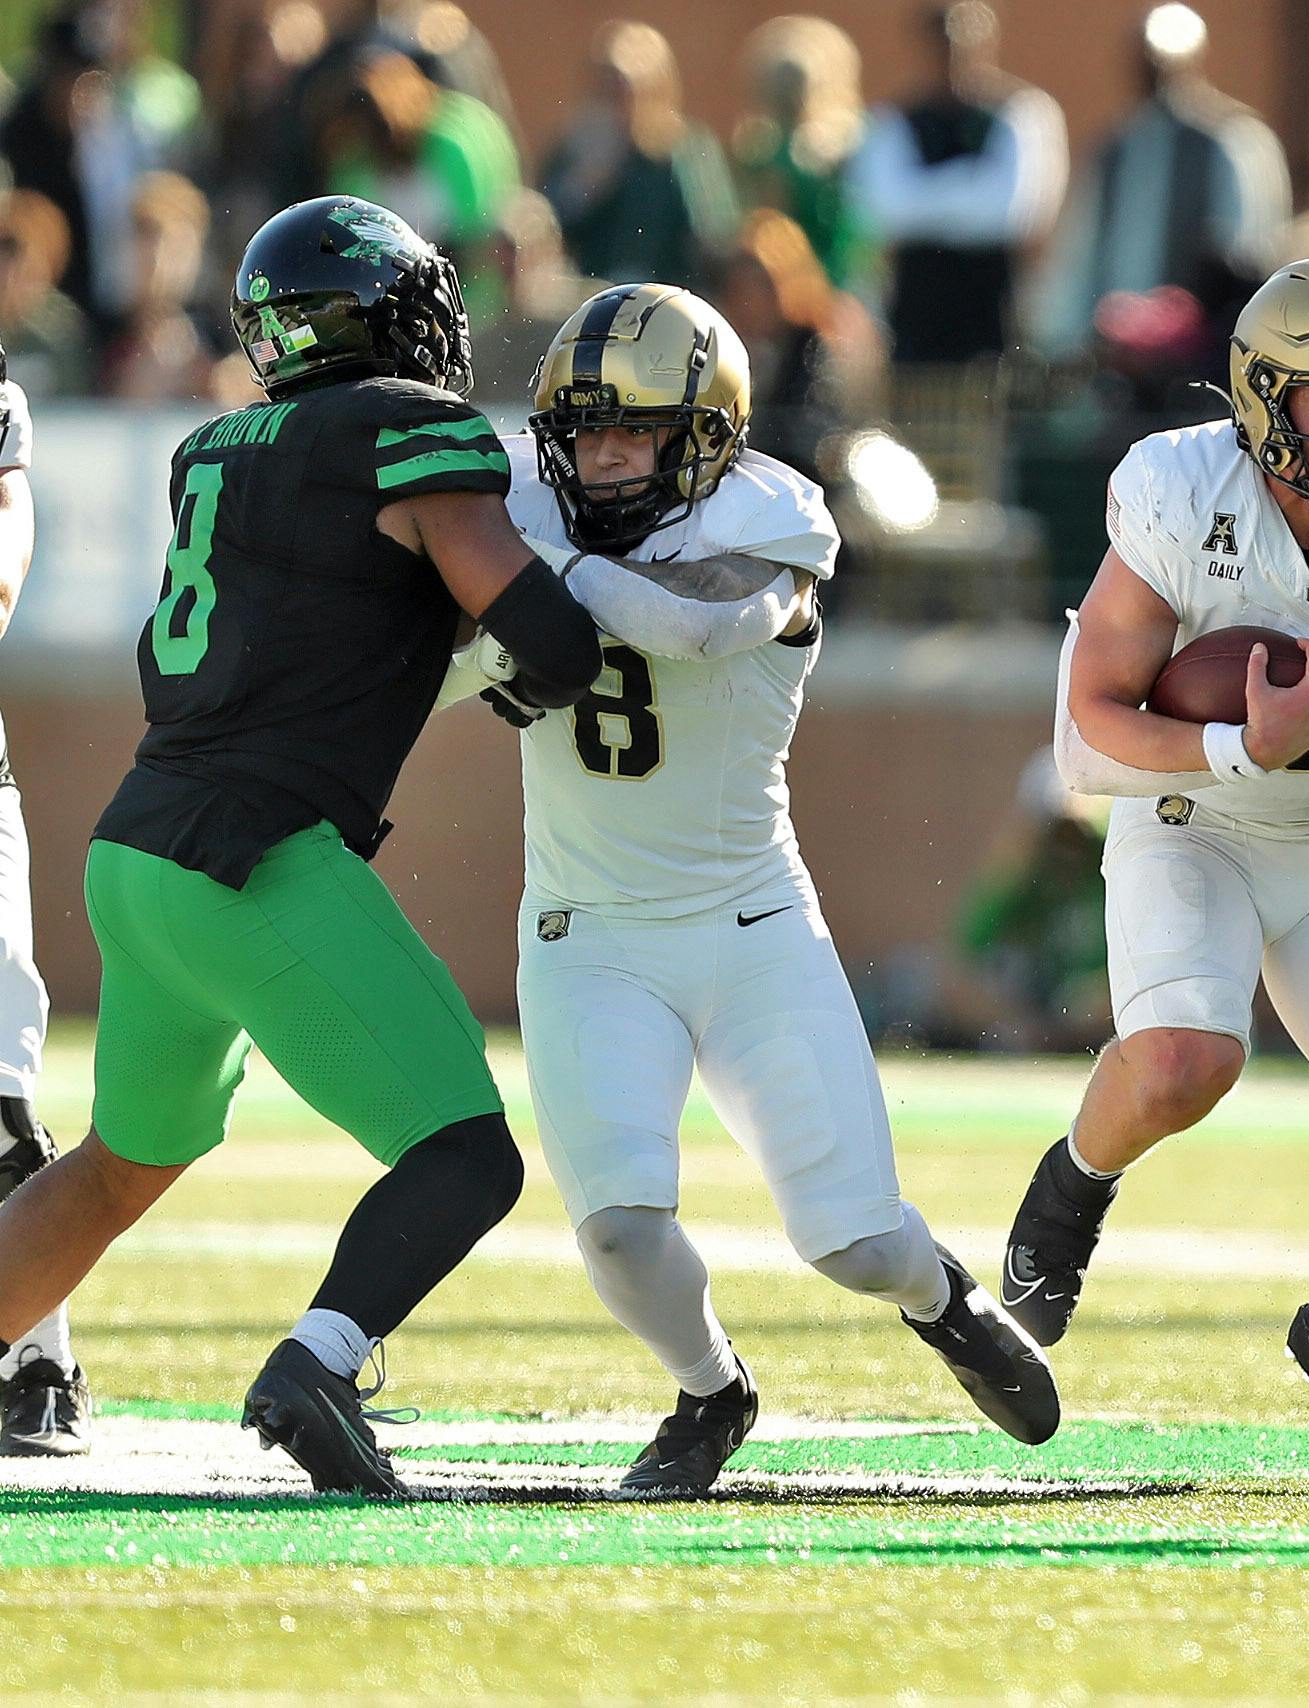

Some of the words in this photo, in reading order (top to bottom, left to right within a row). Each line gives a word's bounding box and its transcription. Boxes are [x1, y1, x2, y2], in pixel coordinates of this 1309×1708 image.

[201, 402, 299, 450] BROWN
[548, 438, 576, 478] KNIGHTS
[1201, 512, 1238, 556] A
[152, 462, 224, 676] 8
[1207, 560, 1245, 581] DAILY
[570, 637, 666, 782] 8
